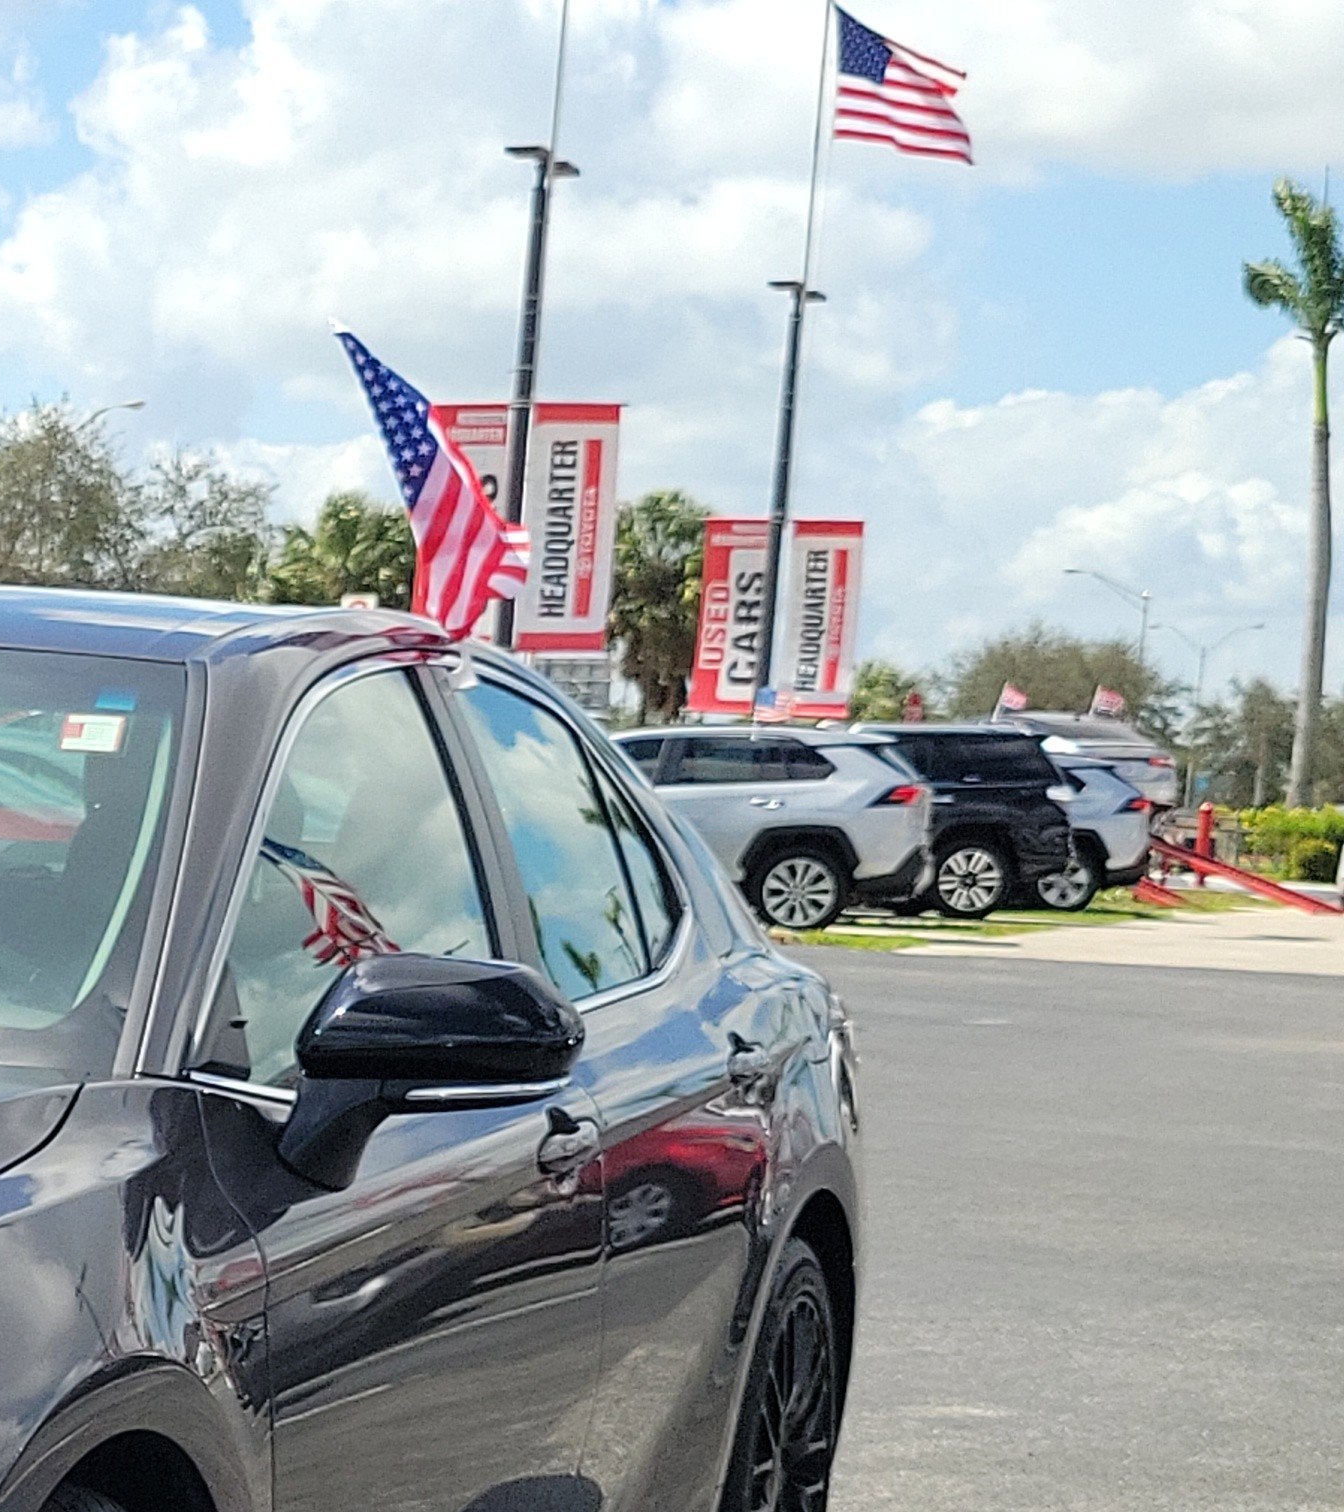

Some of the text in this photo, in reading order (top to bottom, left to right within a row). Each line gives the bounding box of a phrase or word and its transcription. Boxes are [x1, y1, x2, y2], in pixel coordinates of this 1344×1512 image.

[538, 440, 578, 618] HEADQUARTER
[701, 584, 730, 667] USED
[727, 571, 764, 685] CARS
